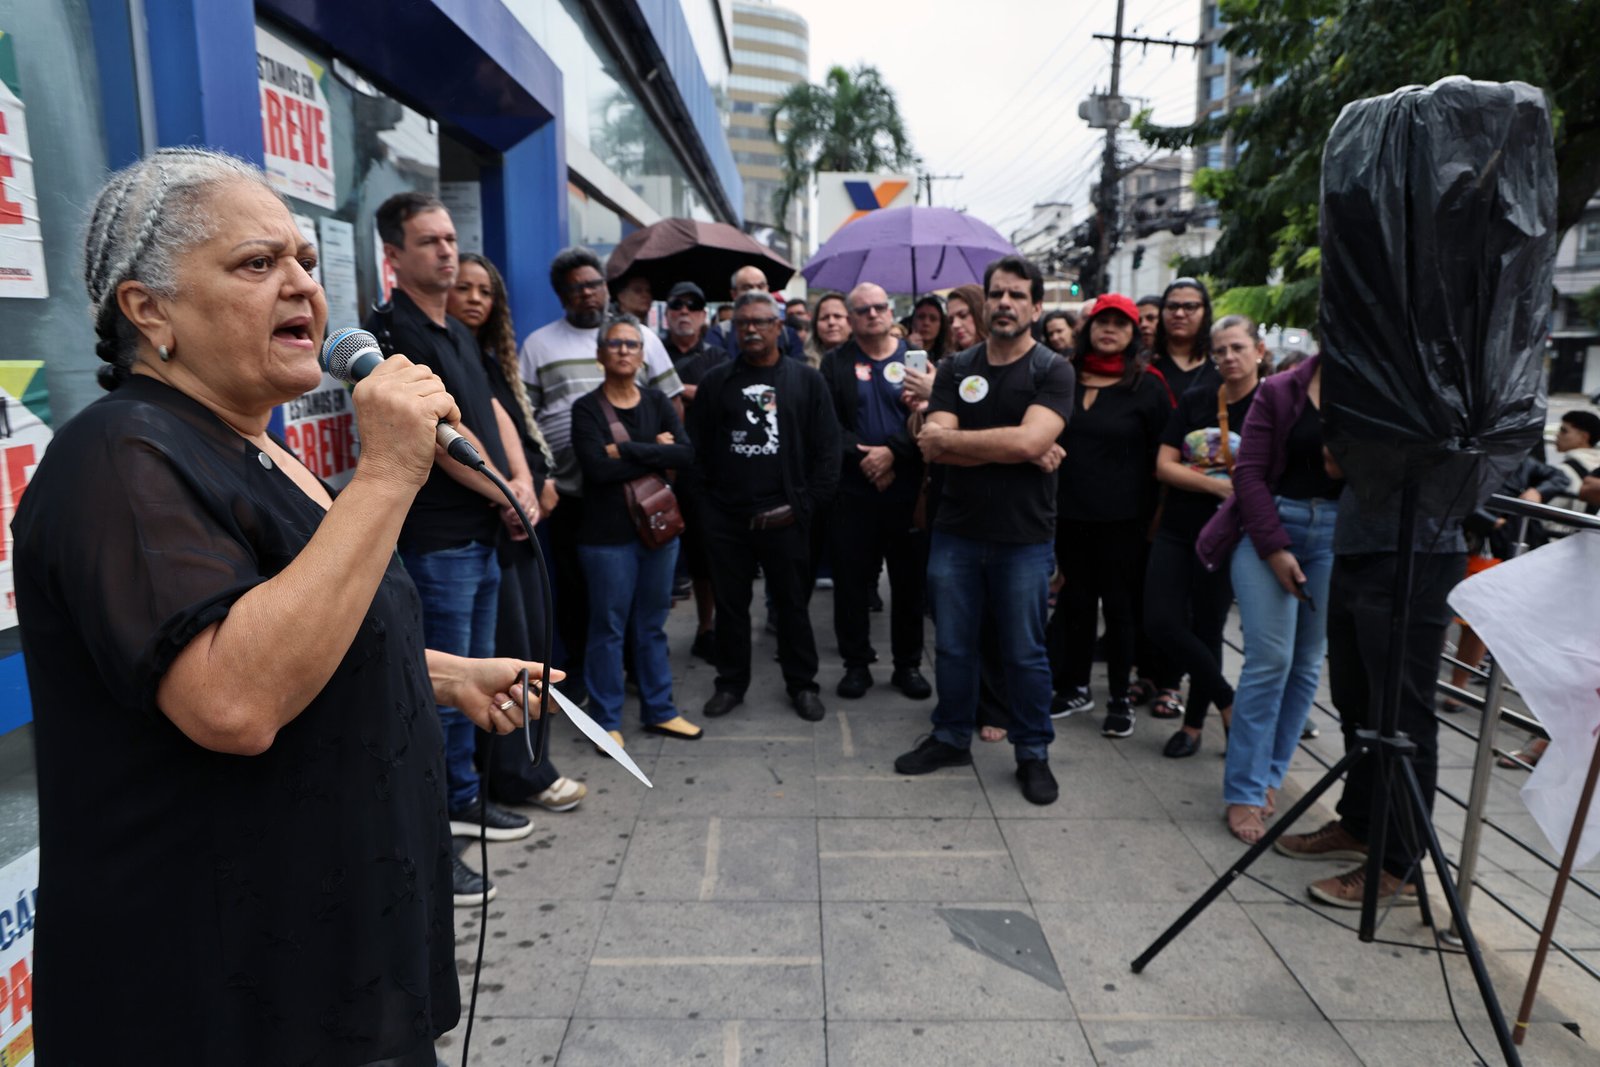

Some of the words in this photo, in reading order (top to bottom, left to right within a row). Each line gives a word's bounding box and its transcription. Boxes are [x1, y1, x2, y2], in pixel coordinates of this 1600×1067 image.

[256, 52, 300, 95] STAMOS
[260, 87, 329, 170] REVE
[285, 413, 357, 478] GREVE
